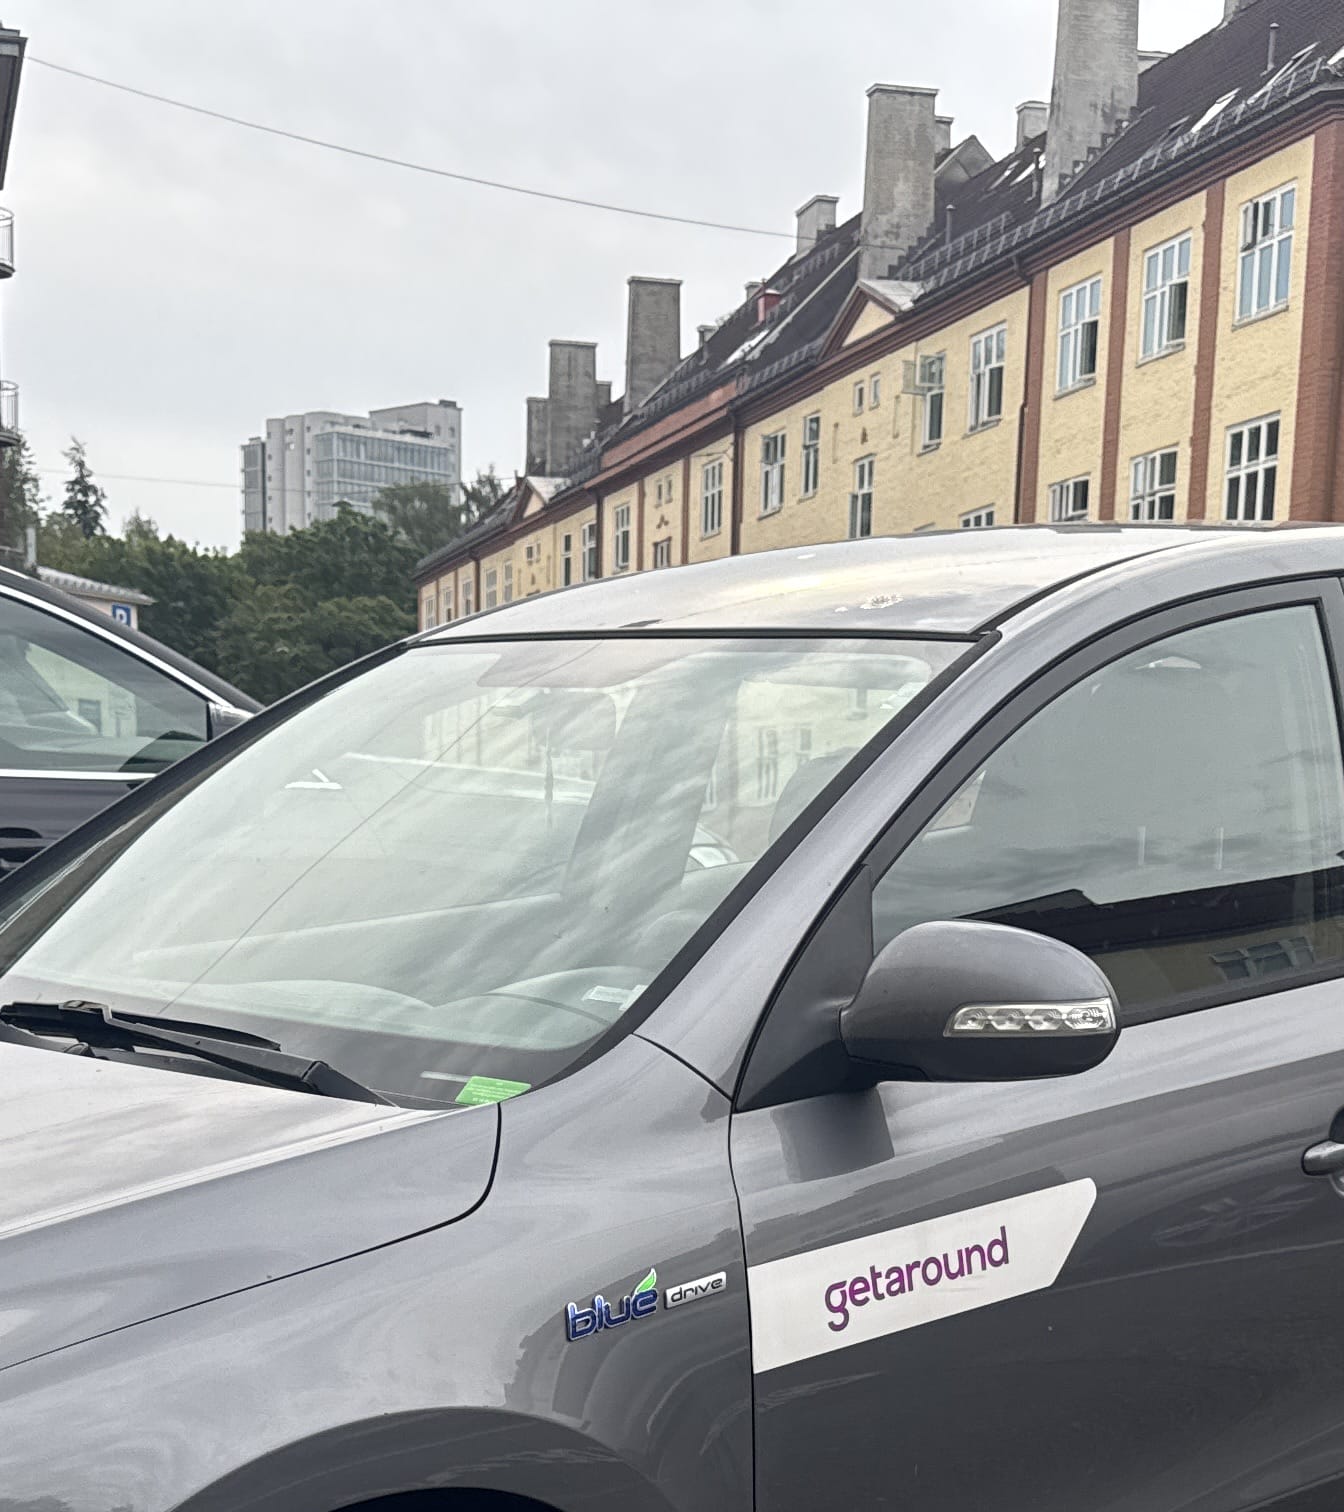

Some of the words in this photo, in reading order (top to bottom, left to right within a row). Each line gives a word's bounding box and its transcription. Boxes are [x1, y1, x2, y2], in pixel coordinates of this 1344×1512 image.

[115, 607, 128, 624] P
[565, 1288, 658, 1342] blue
[670, 1277, 724, 1303] drive
[824, 1225, 1010, 1332] getaround
